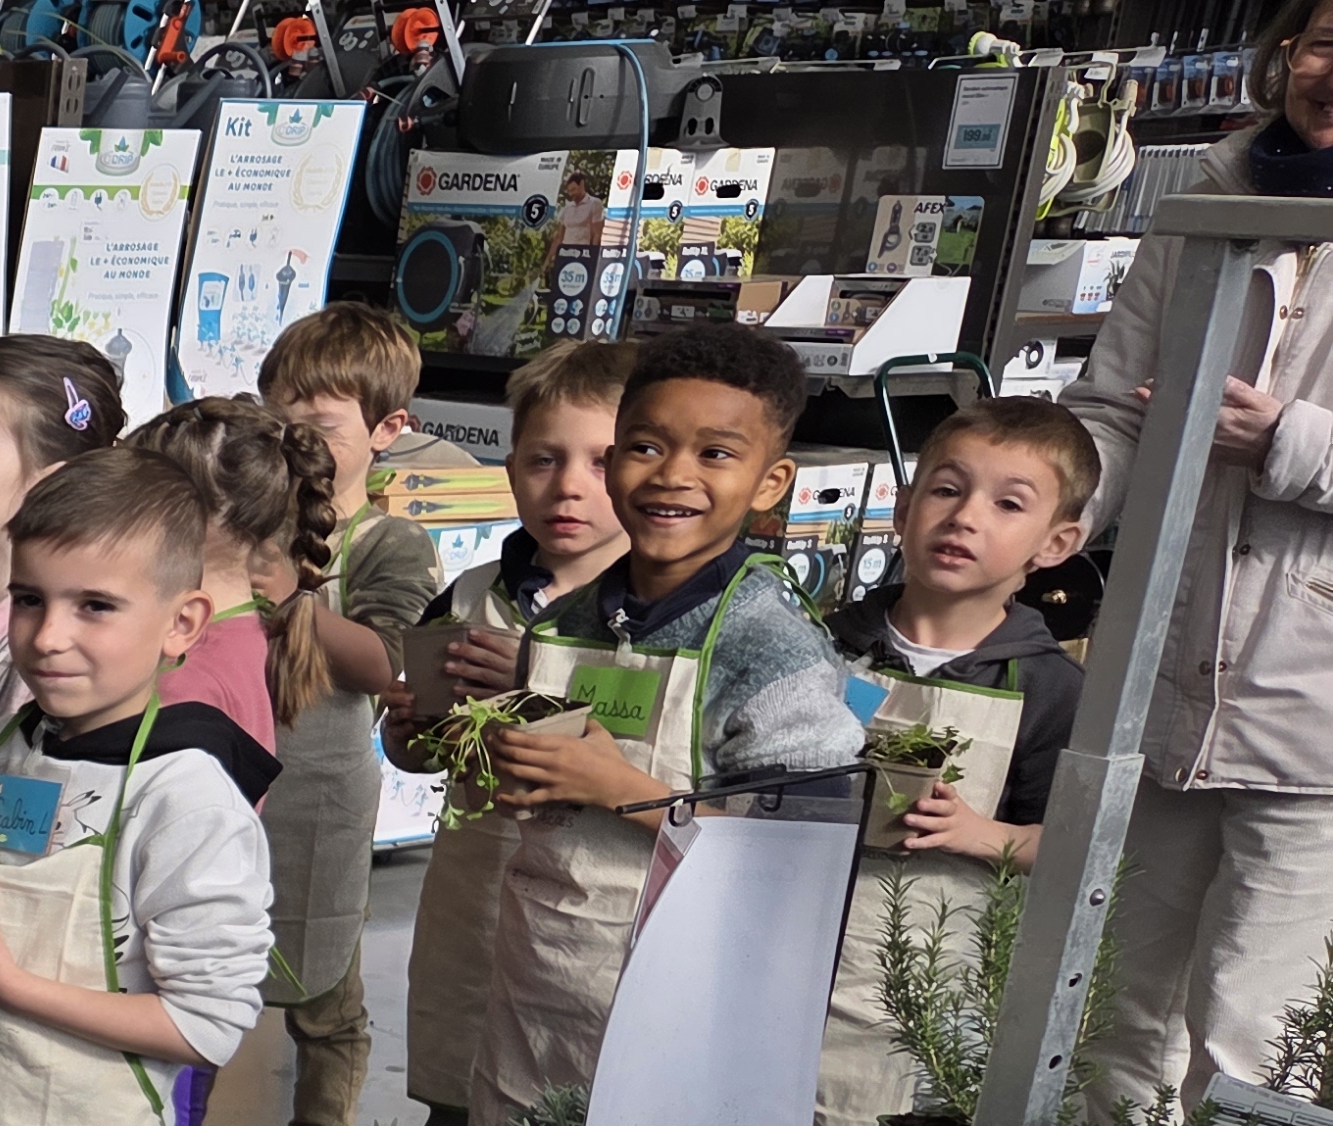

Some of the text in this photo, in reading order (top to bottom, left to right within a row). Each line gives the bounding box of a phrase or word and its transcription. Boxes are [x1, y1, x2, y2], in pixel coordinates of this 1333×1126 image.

[225, 117, 252, 137] Kit
[230, 154, 284, 165] L'ARROSAGE
[215, 168, 225, 177] LE
[235, 166, 292, 178] ÉCONOMIQUE
[228, 182, 274, 191] AU MONDE
[438, 172, 518, 192] GARDENA
[106, 242, 159, 252] L'ARROSAGE
[90, 257, 101, 266] LE
[111, 254, 170, 266] ÉCONOMIQUE
[104, 270, 151, 279] AU MONDE
[422, 421, 500, 446] GARDENA
[576, 684, 646, 721] Massa
